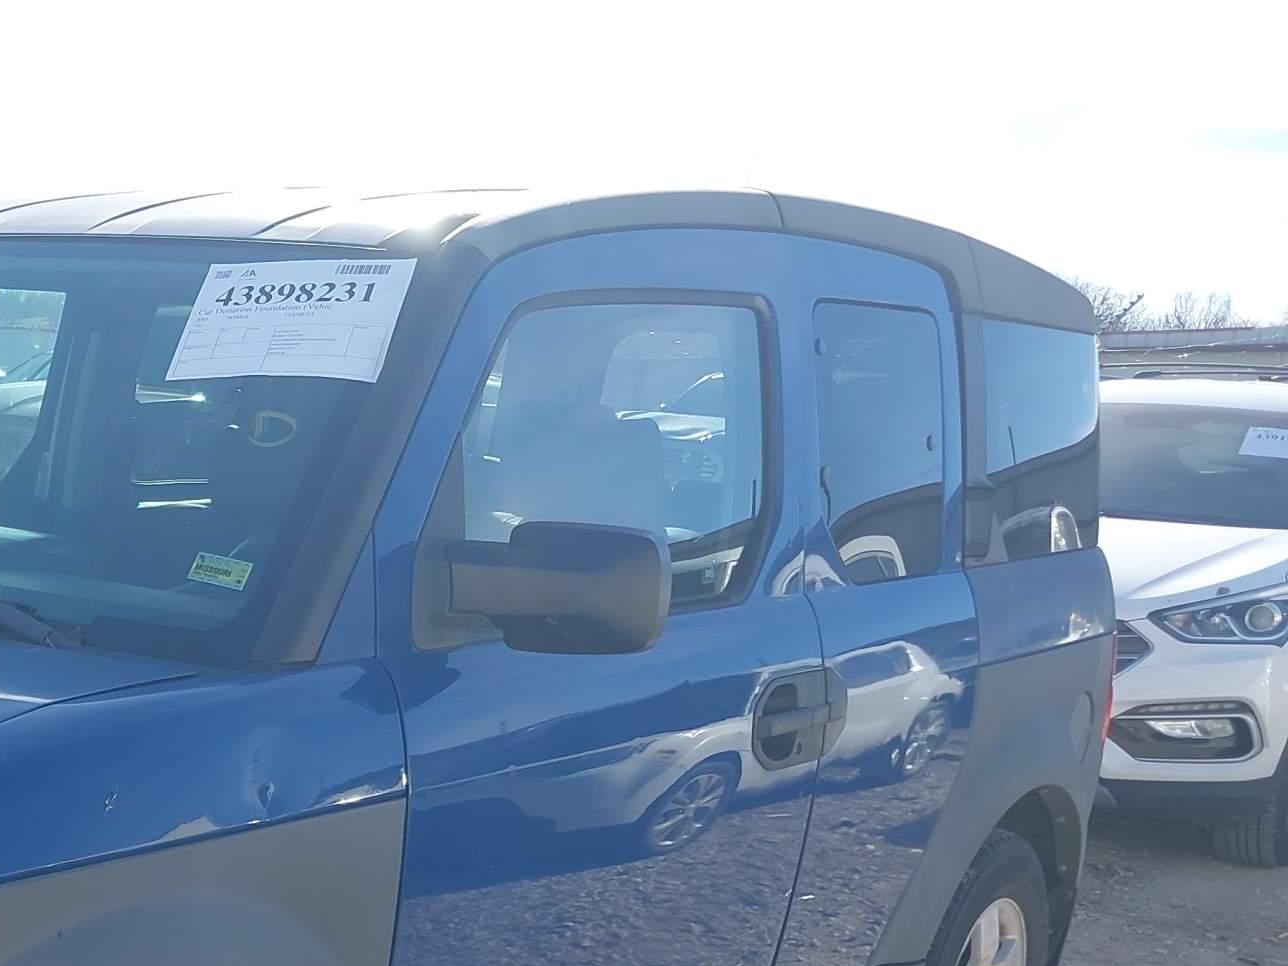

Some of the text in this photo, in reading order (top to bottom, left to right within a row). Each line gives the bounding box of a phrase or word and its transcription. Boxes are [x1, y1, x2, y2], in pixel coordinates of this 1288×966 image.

[215, 282, 376, 307] 43898231
[215, 307, 253, 315] Donation
[254, 304, 301, 312] Foundation
[195, 563, 233, 578] MISSOURI
